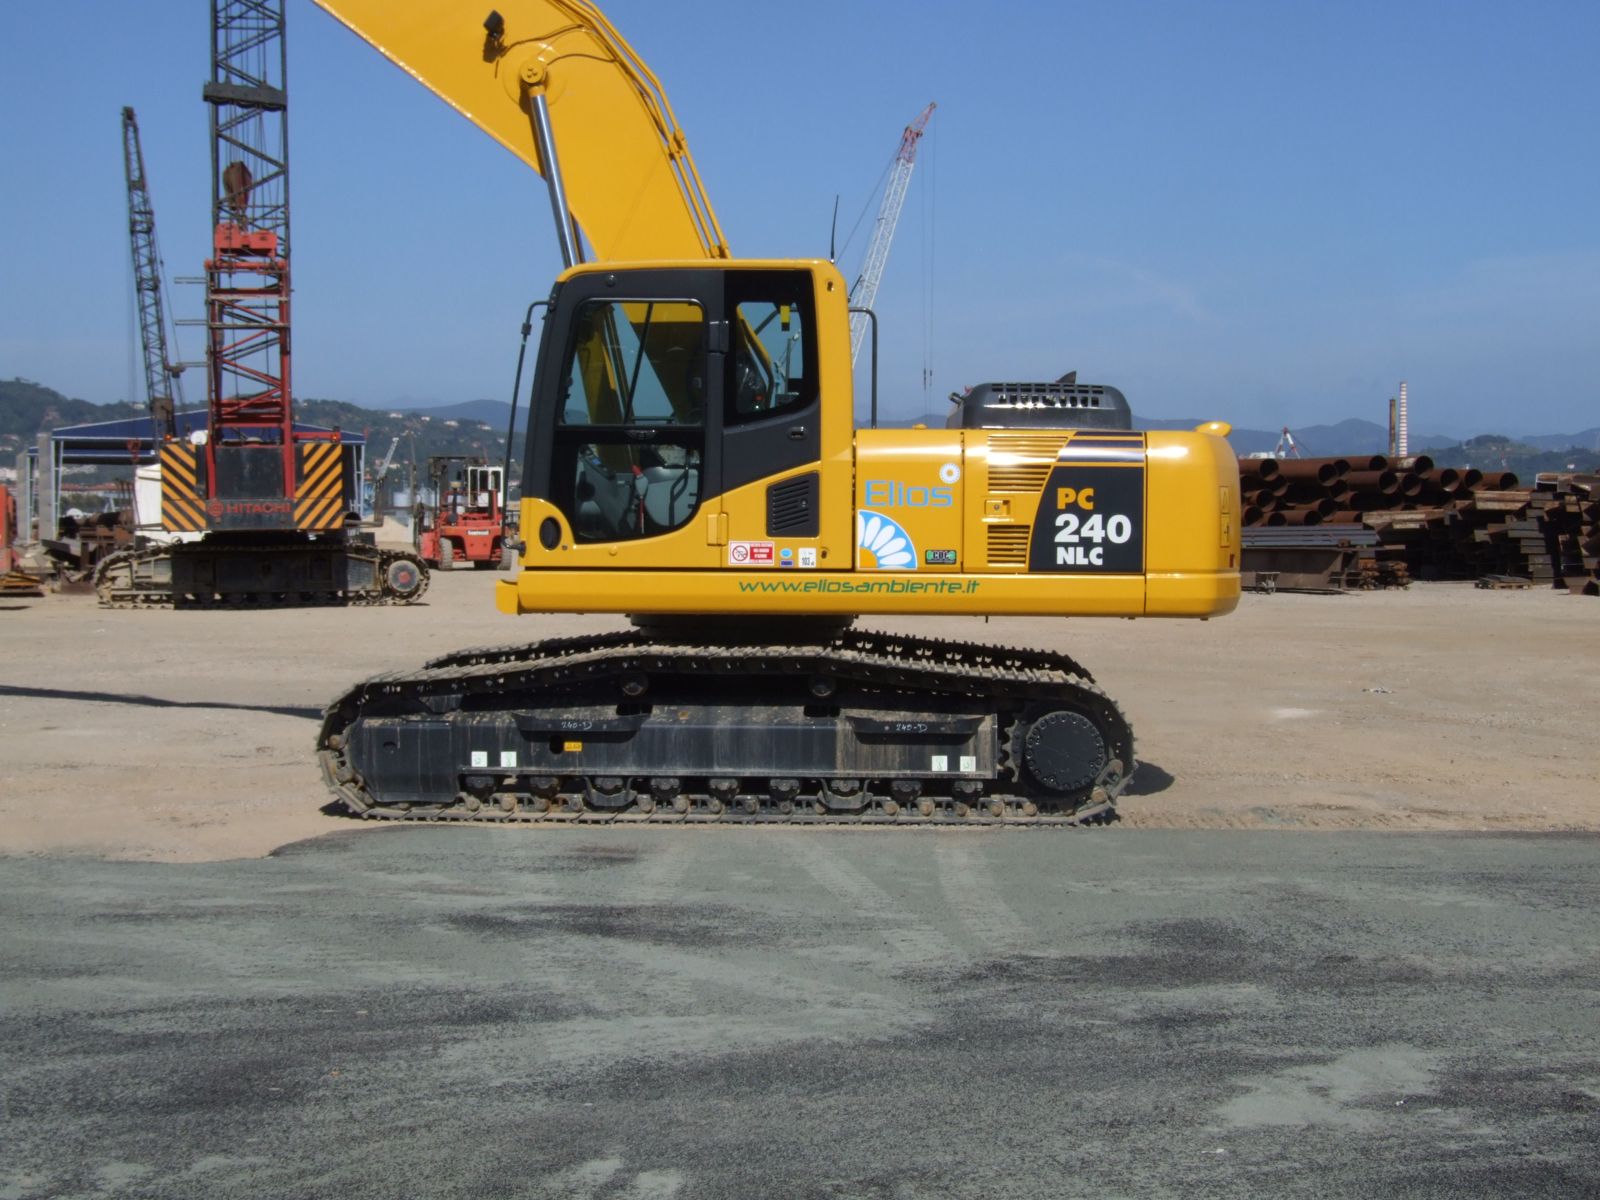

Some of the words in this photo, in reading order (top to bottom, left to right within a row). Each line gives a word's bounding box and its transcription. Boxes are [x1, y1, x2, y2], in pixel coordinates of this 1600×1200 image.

[865, 480, 953, 507] Elios
[1056, 487, 1094, 510] PC
[226, 503, 291, 513] HITACHI
[1054, 513, 1132, 544] 240
[1056, 547, 1103, 566] NLC
[738, 579, 980, 594] www.eliosambiente.it
